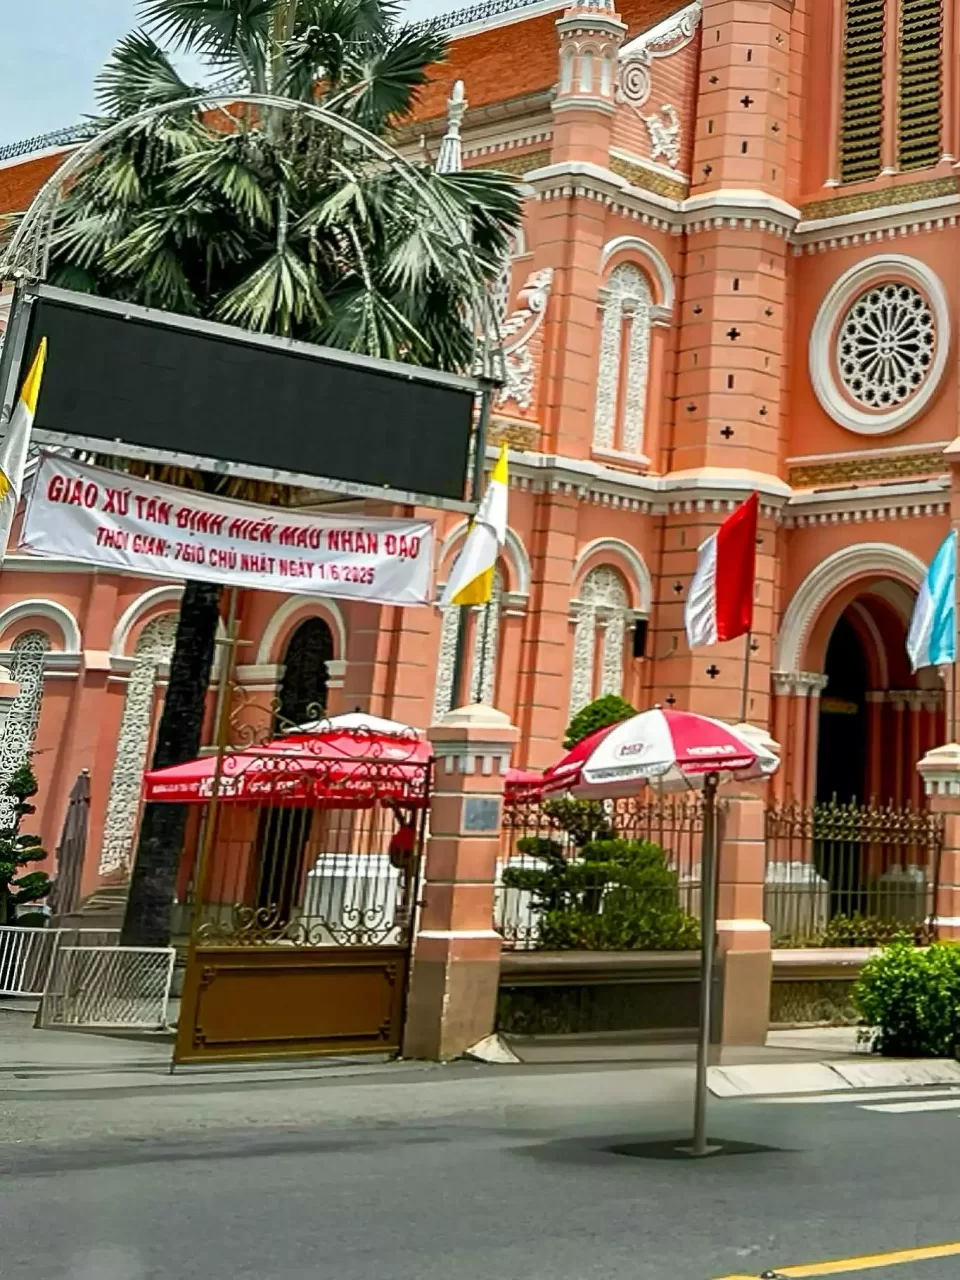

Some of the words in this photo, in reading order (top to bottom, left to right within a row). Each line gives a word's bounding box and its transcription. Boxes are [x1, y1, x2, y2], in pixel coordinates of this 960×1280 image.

[47, 474, 98, 509] GIÁO
[102, 487, 132, 516] XỨ
[135, 495, 173, 525] TÂN
[175, 507, 227, 536] ĐỊNH
[228, 516, 278, 544] HIẾN
[279, 524, 323, 550] MÁU
[327, 527, 378, 555] NHÂN
[384, 533, 421, 563] ĐẠO
[209, 546, 237, 570] CHỦ
[279, 556, 315, 578] NGÀY
